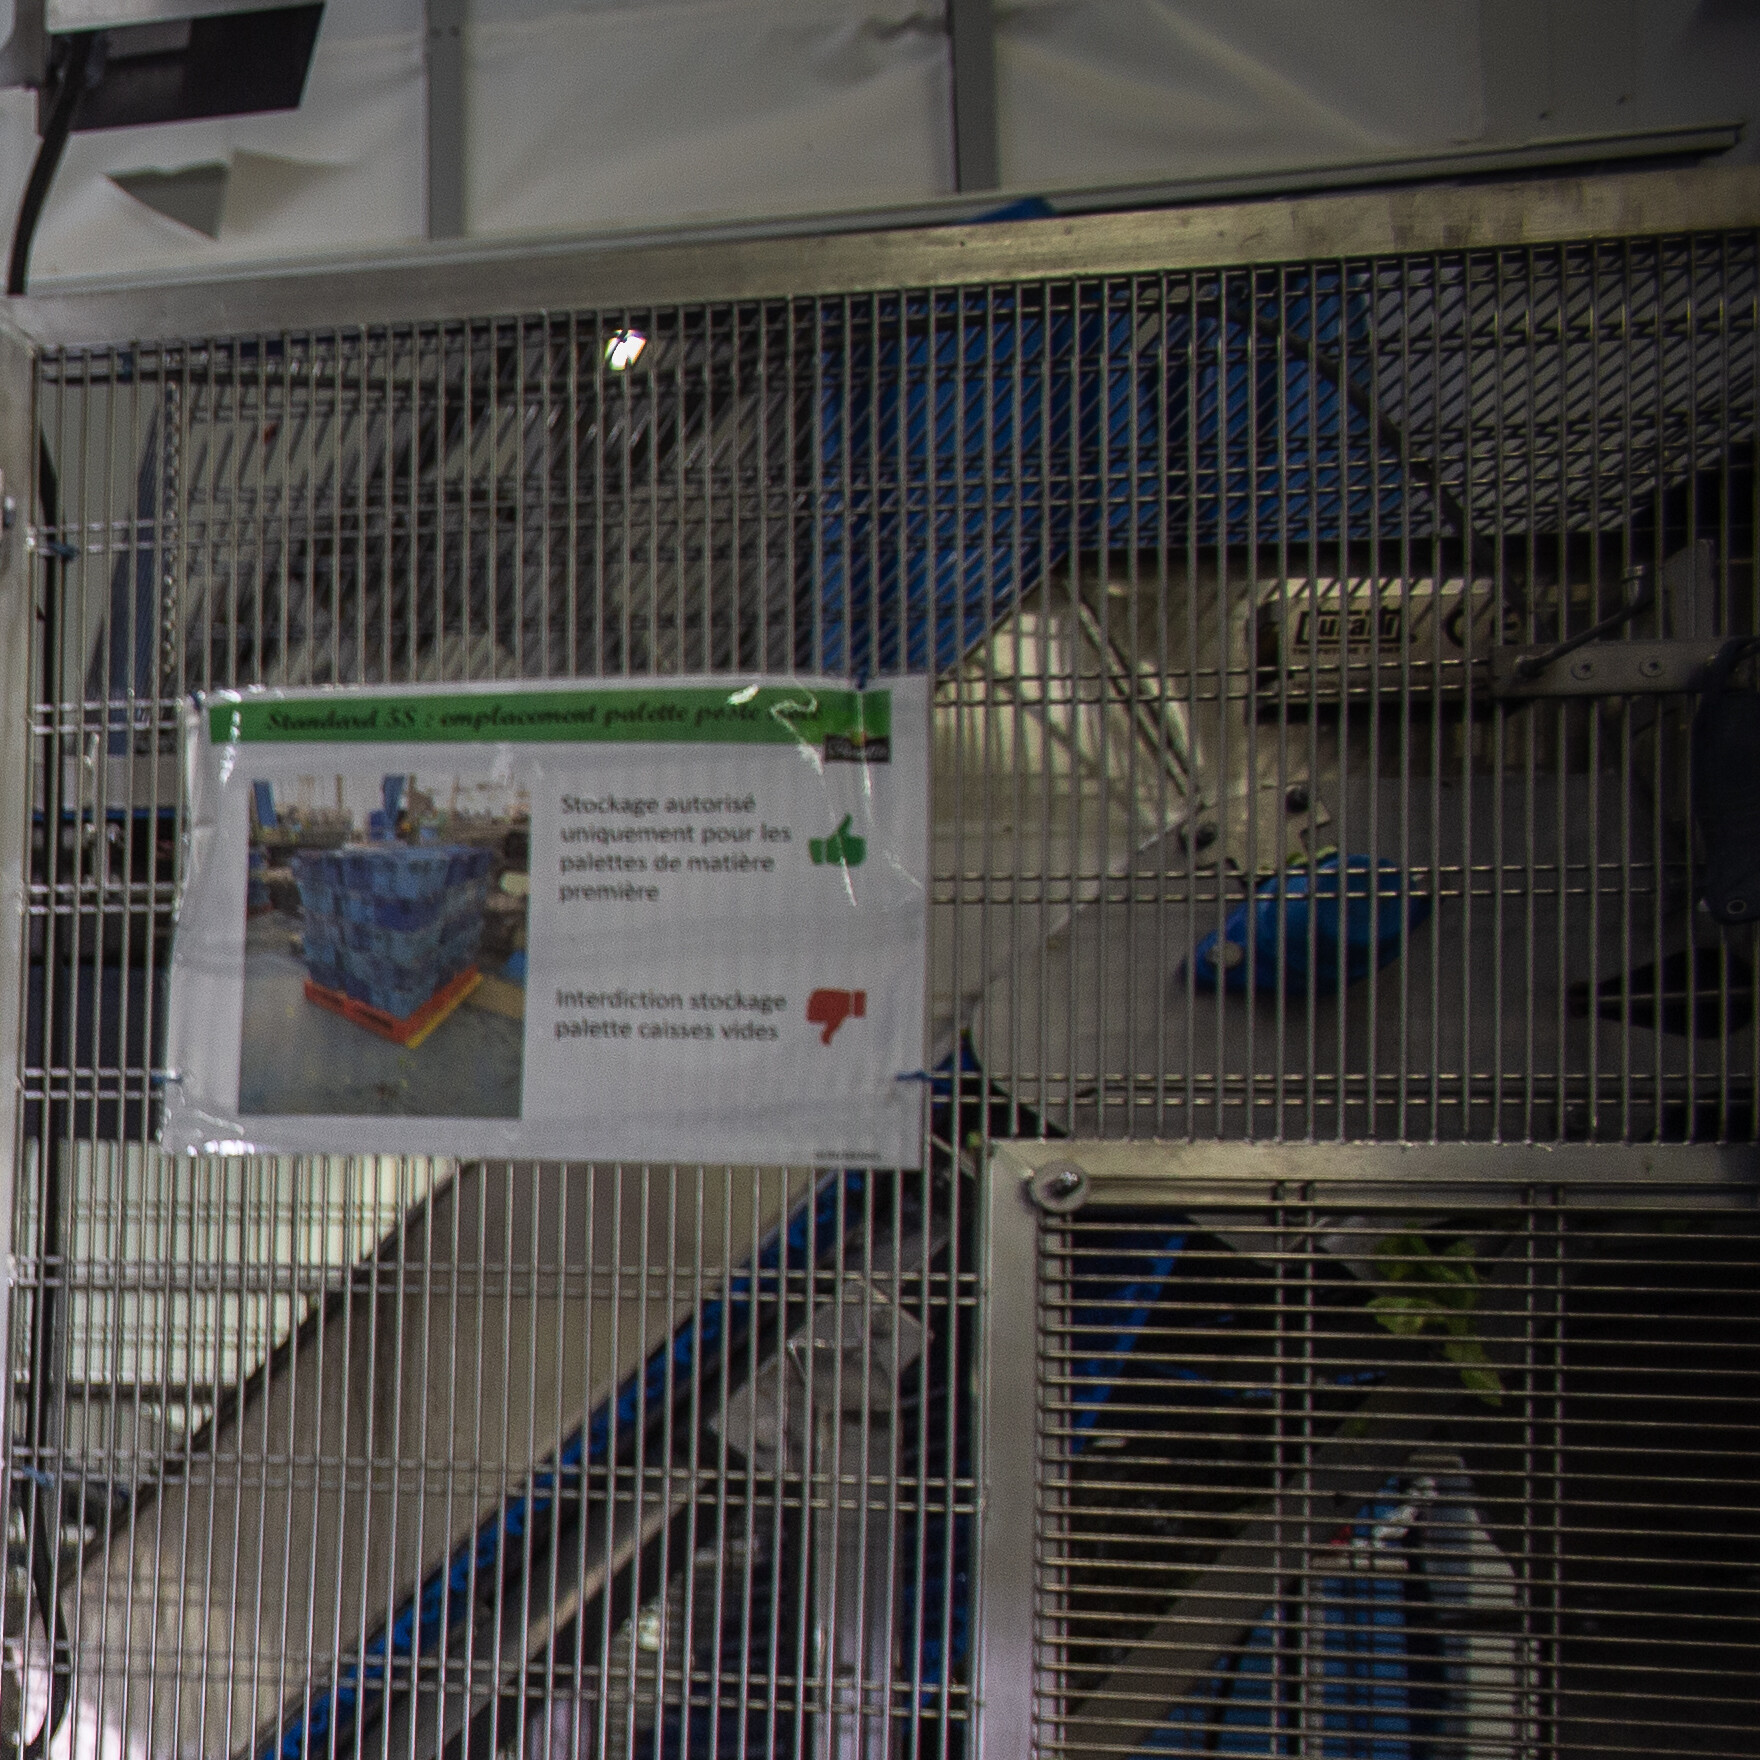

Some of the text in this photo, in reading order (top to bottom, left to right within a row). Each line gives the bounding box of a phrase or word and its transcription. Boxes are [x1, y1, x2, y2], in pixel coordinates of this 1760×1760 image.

[268, 707, 379, 731] Standard
[385, 705, 417, 729] 5S
[440, 703, 597, 732] emplacement
[603, 702, 686, 728] palette
[560, 793, 757, 818] Stockage autorisé
[560, 822, 792, 847] uniquement pour les
[559, 852, 776, 876] palettes de matière
[559, 881, 660, 903] première
[555, 988, 788, 1015] Interdiction stockage
[554, 1018, 779, 1042] palette caisses vides
